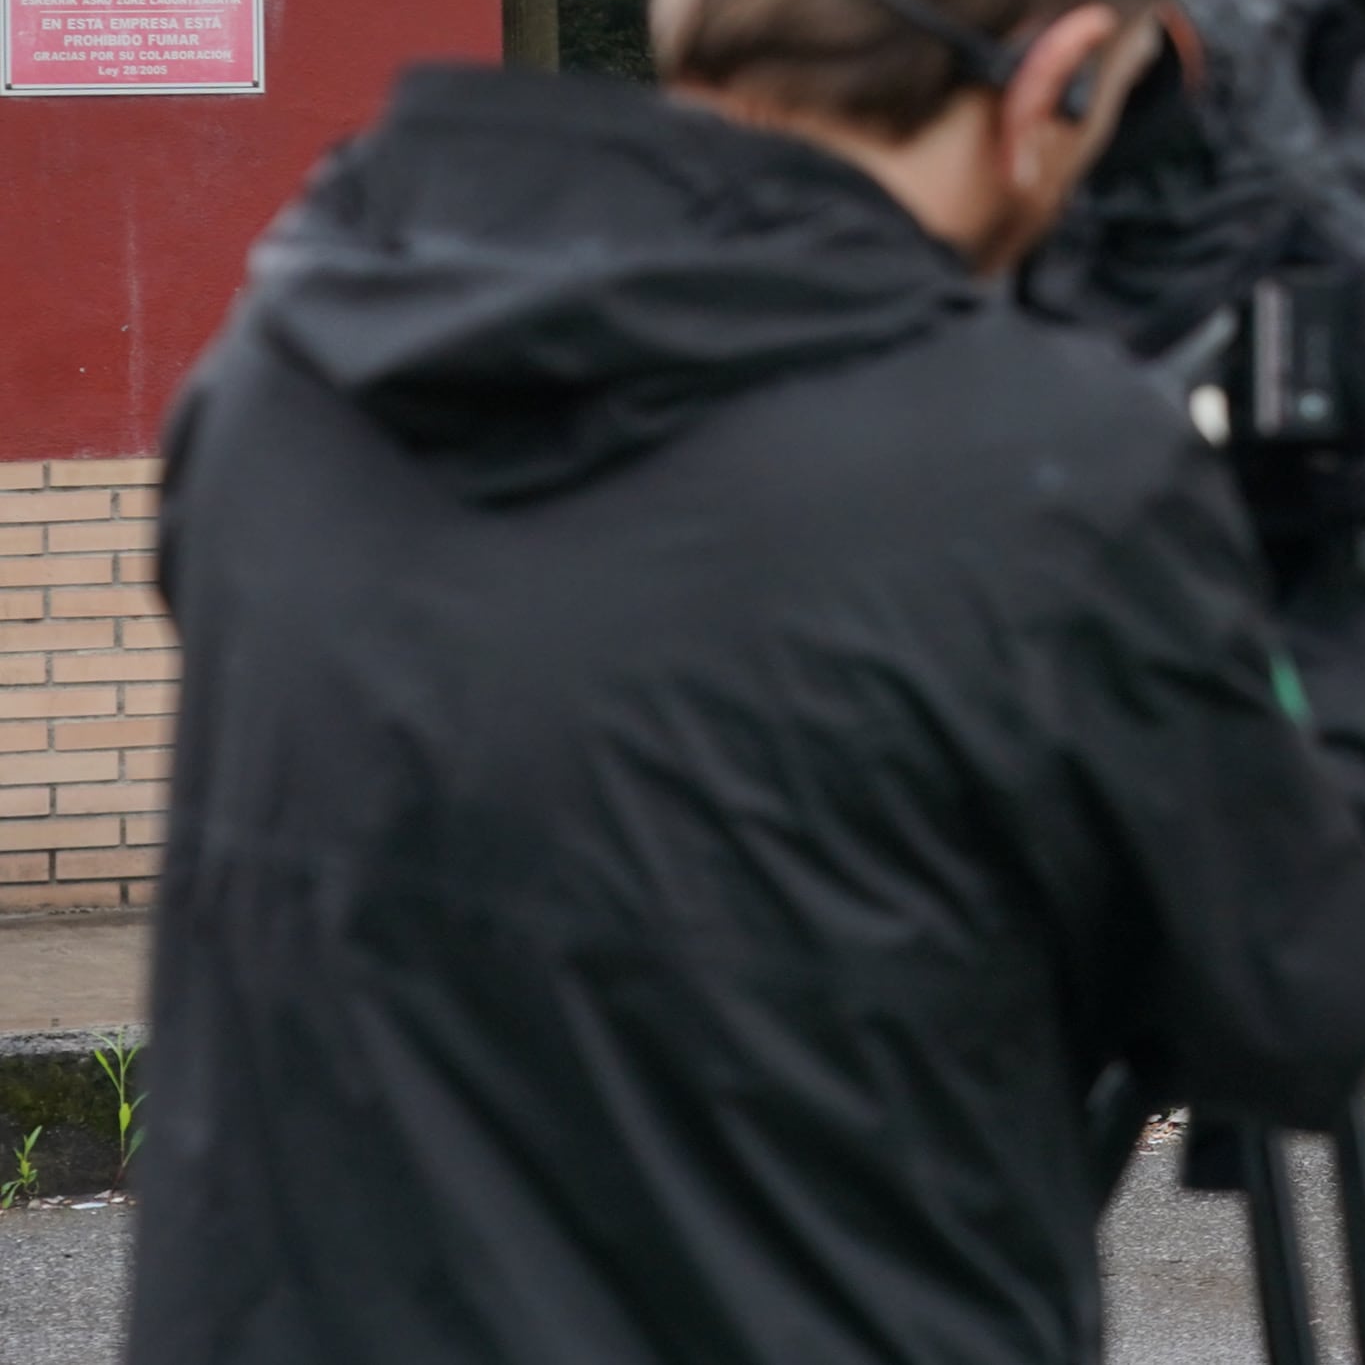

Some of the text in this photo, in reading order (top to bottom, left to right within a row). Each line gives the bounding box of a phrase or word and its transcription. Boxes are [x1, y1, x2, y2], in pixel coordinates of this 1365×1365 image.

[41, 18, 62, 30] EN
[67, 18, 104, 30] ESTA
[110, 17, 179, 30] EMPRESA
[63, 33, 200, 46] PROHIBIDO FUMAR
[33, 51, 86, 61] GRACIAS
[90, 50, 114, 61] POR
[119, 50, 135, 60] SU
[98, 65, 118, 77] Ley
